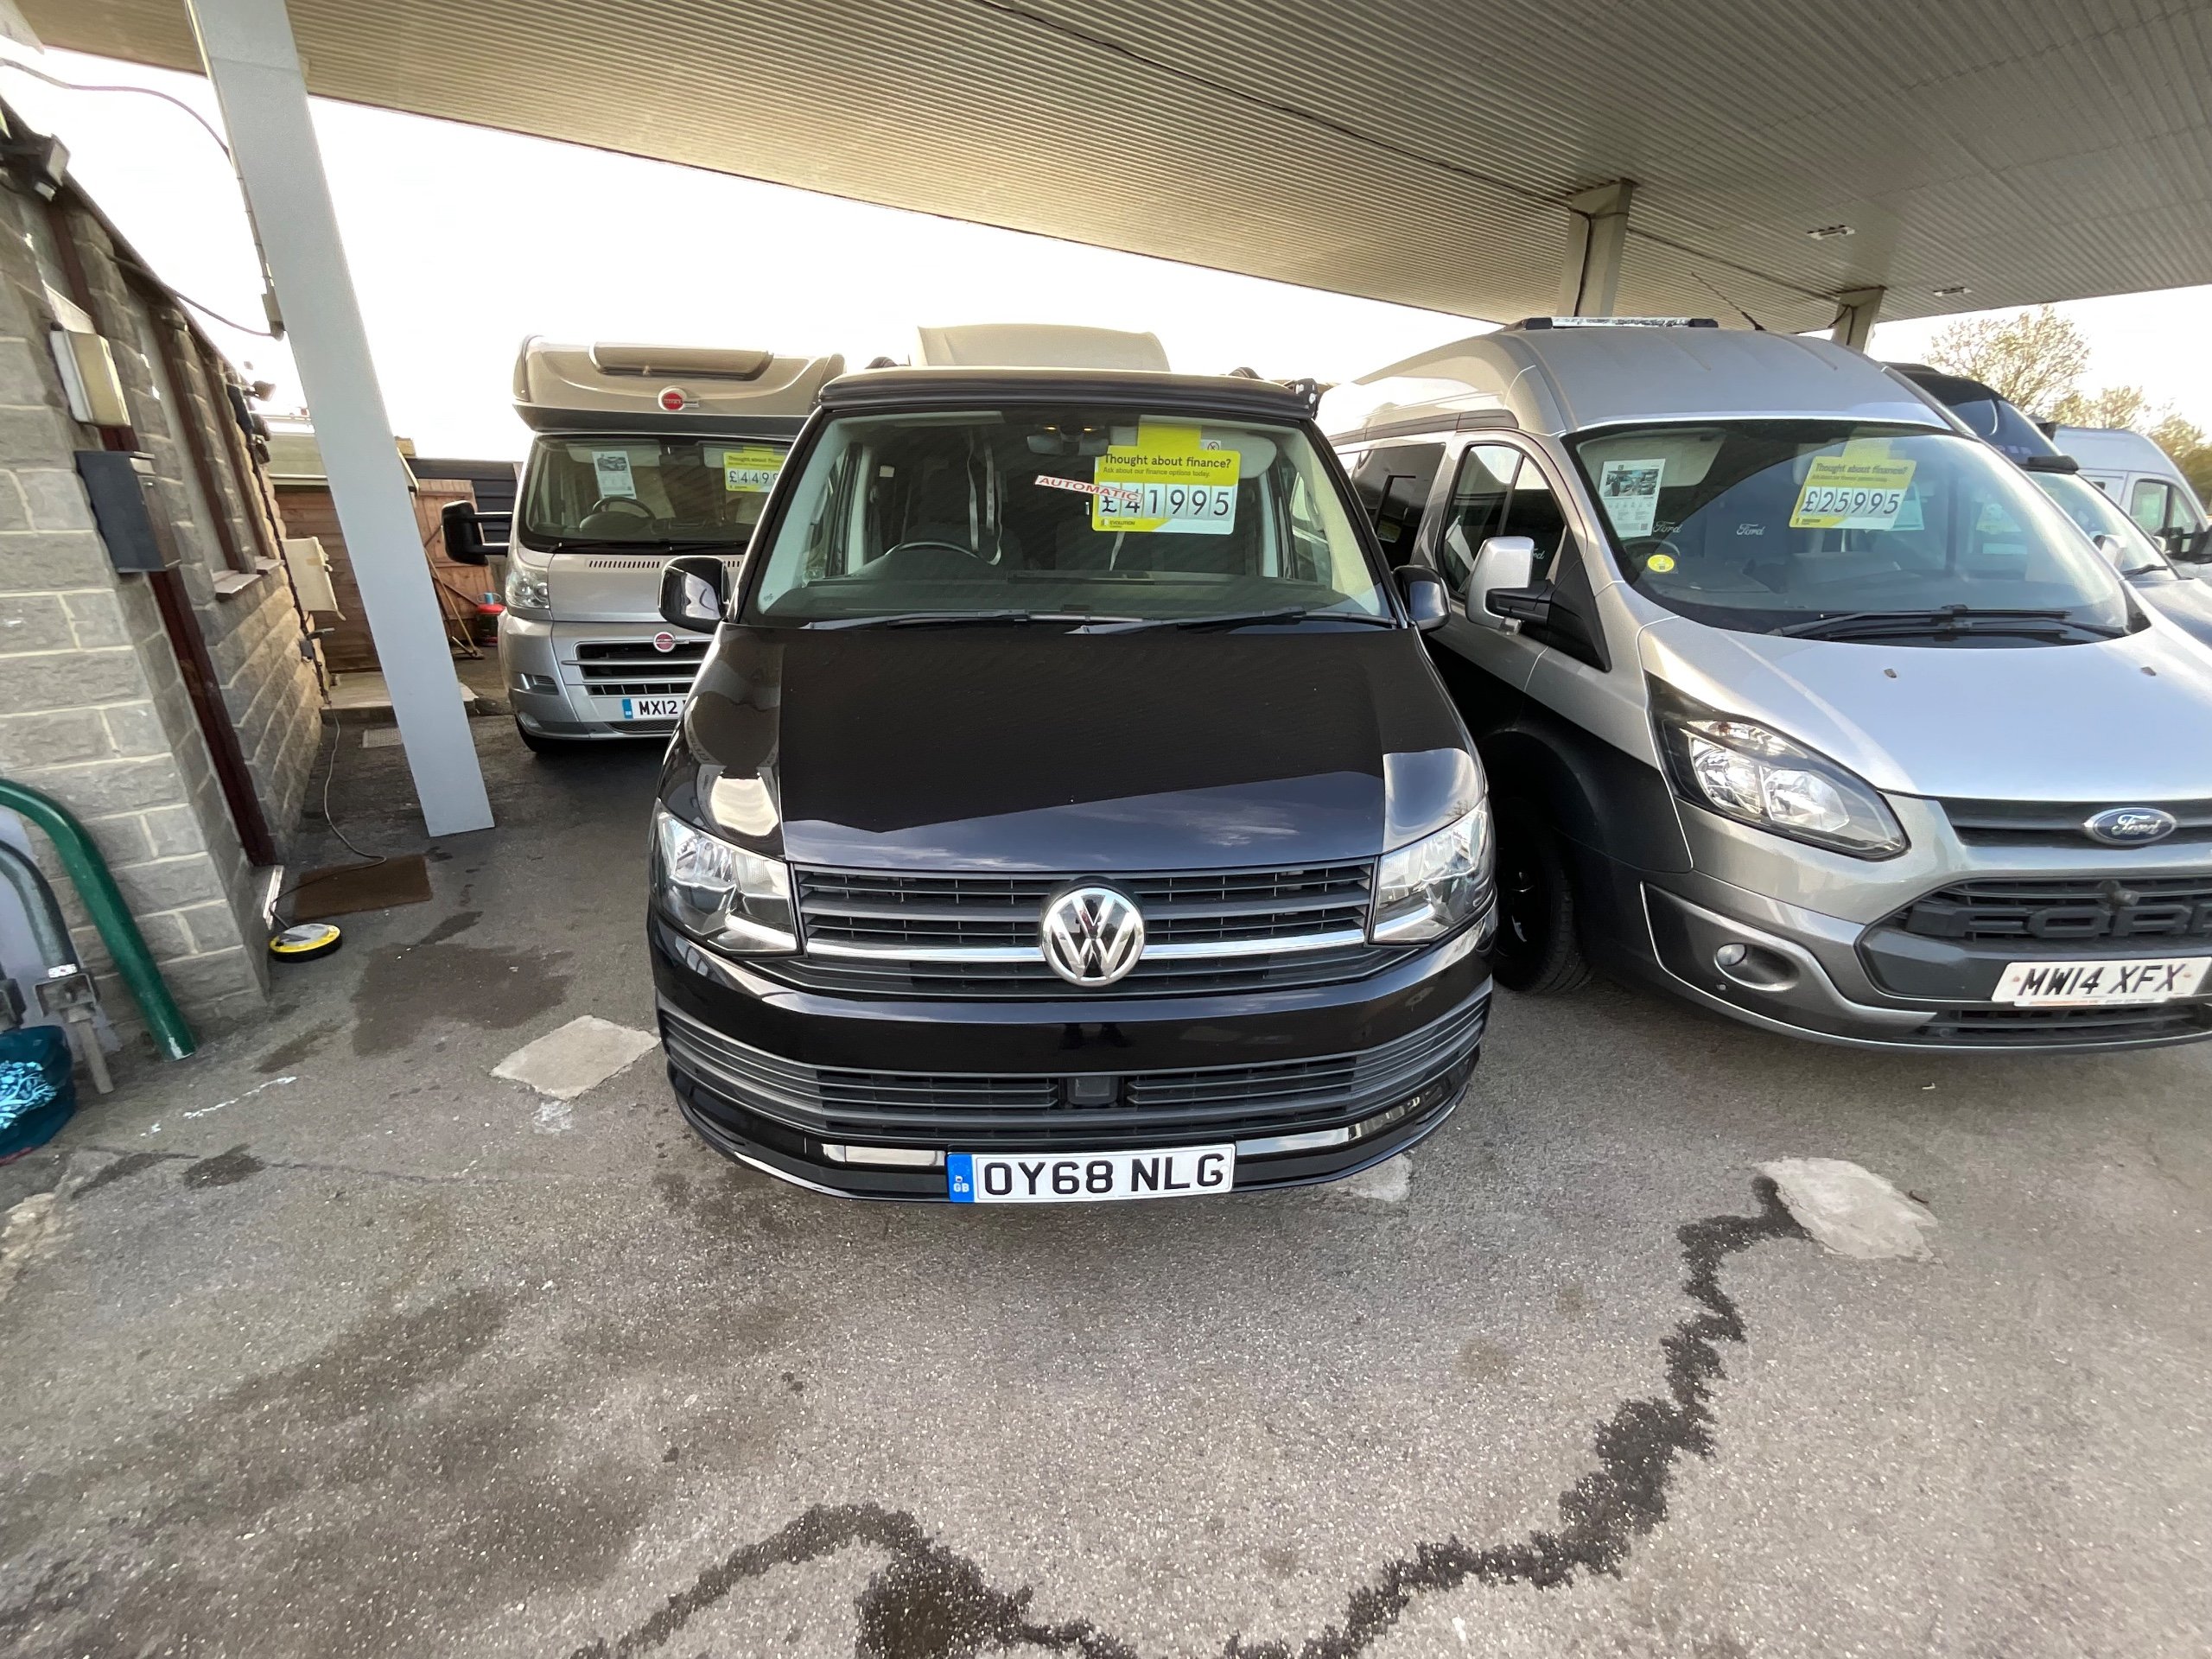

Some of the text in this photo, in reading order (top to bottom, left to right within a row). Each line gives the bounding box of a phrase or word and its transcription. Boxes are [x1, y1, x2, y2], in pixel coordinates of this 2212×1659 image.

[1104, 454, 1231, 468] Thought about finance?
[1815, 462, 1845, 474] Thought
[1847, 464, 1871, 474] about
[1039, 477, 1139, 500] AUTOMATIC
[1802, 491, 1901, 514] £25995
[1652, 520, 1683, 534] Ford
[1736, 523, 1766, 536] Ford
[639, 700, 678, 715] MX12
[2111, 814, 2162, 836] Ford
[2017, 963, 2186, 995] MW14 XFX
[983, 1153, 1225, 1195] OY68 NLG
[953, 1182, 969, 1192] GB
